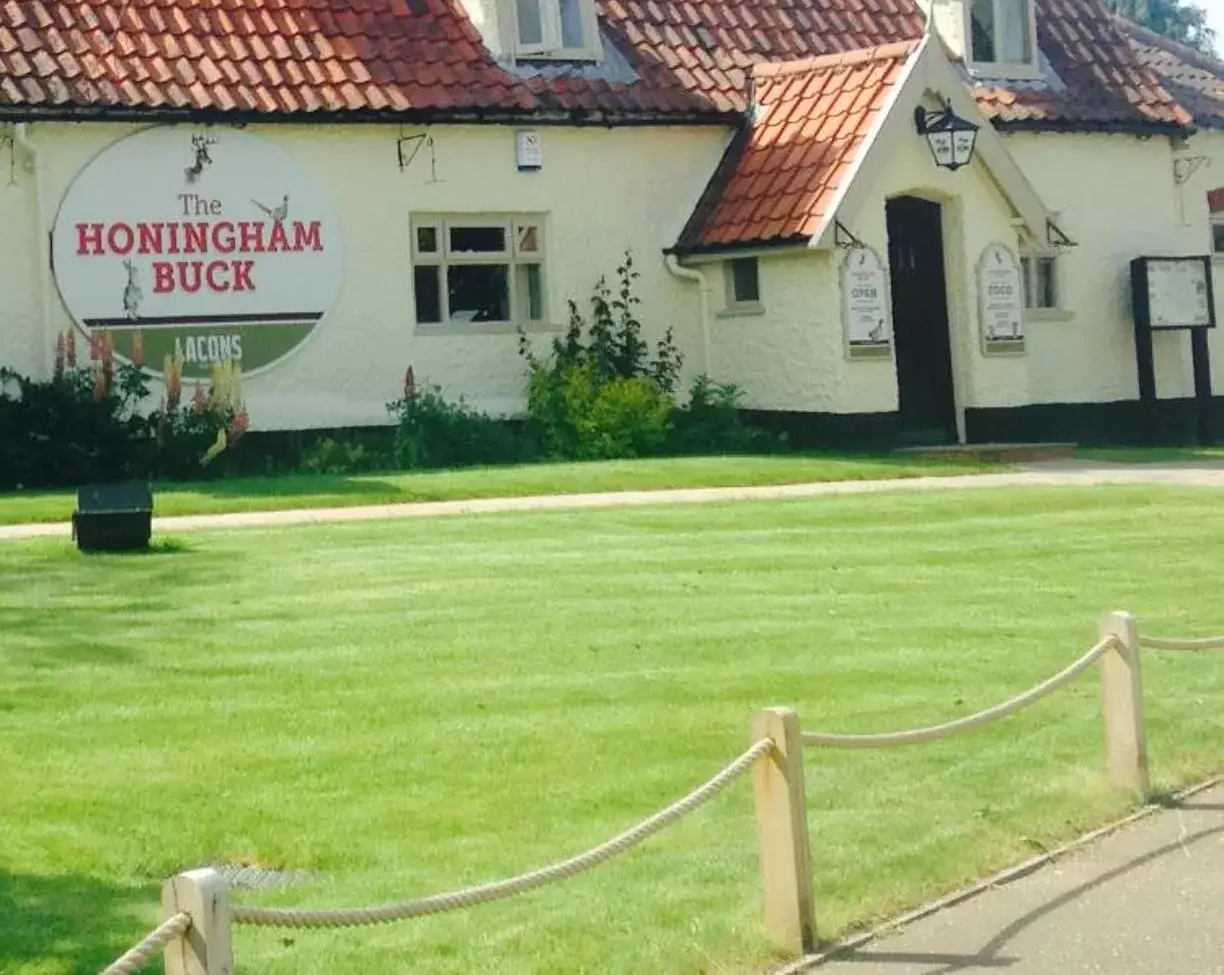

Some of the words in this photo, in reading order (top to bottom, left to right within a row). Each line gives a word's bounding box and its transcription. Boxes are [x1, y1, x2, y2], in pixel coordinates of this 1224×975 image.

[178, 193, 222, 215] The
[76, 222, 323, 255] HONINGHAM
[152, 261, 255, 293] BUCK
